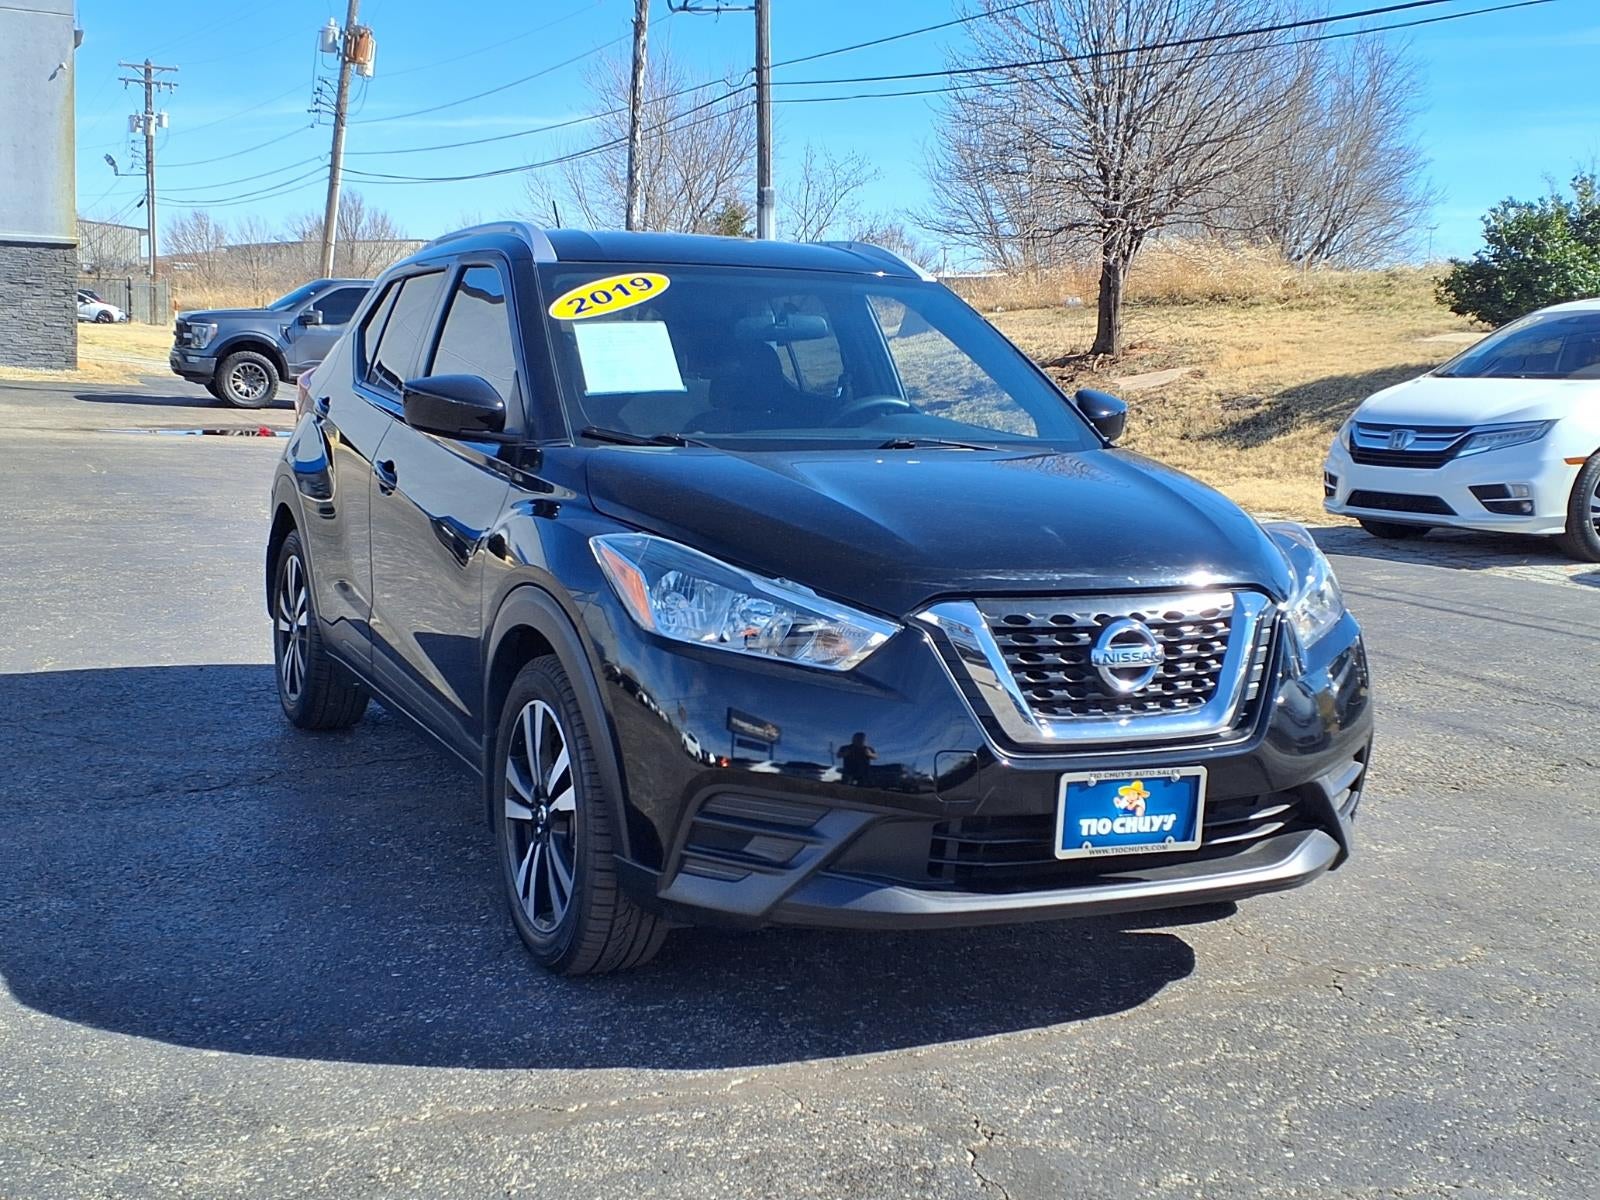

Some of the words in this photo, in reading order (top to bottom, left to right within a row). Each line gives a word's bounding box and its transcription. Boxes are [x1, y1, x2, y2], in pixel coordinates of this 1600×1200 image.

[567, 277, 652, 315] 2019
[1103, 652, 1160, 663] NISSAN
[1157, 768, 1180, 776] SALES
[1079, 817, 1112, 836] TIO
[1113, 813, 1177, 834] CHUY'S
[1089, 844, 1168, 856] WWW.TIOCHUYS.COM
